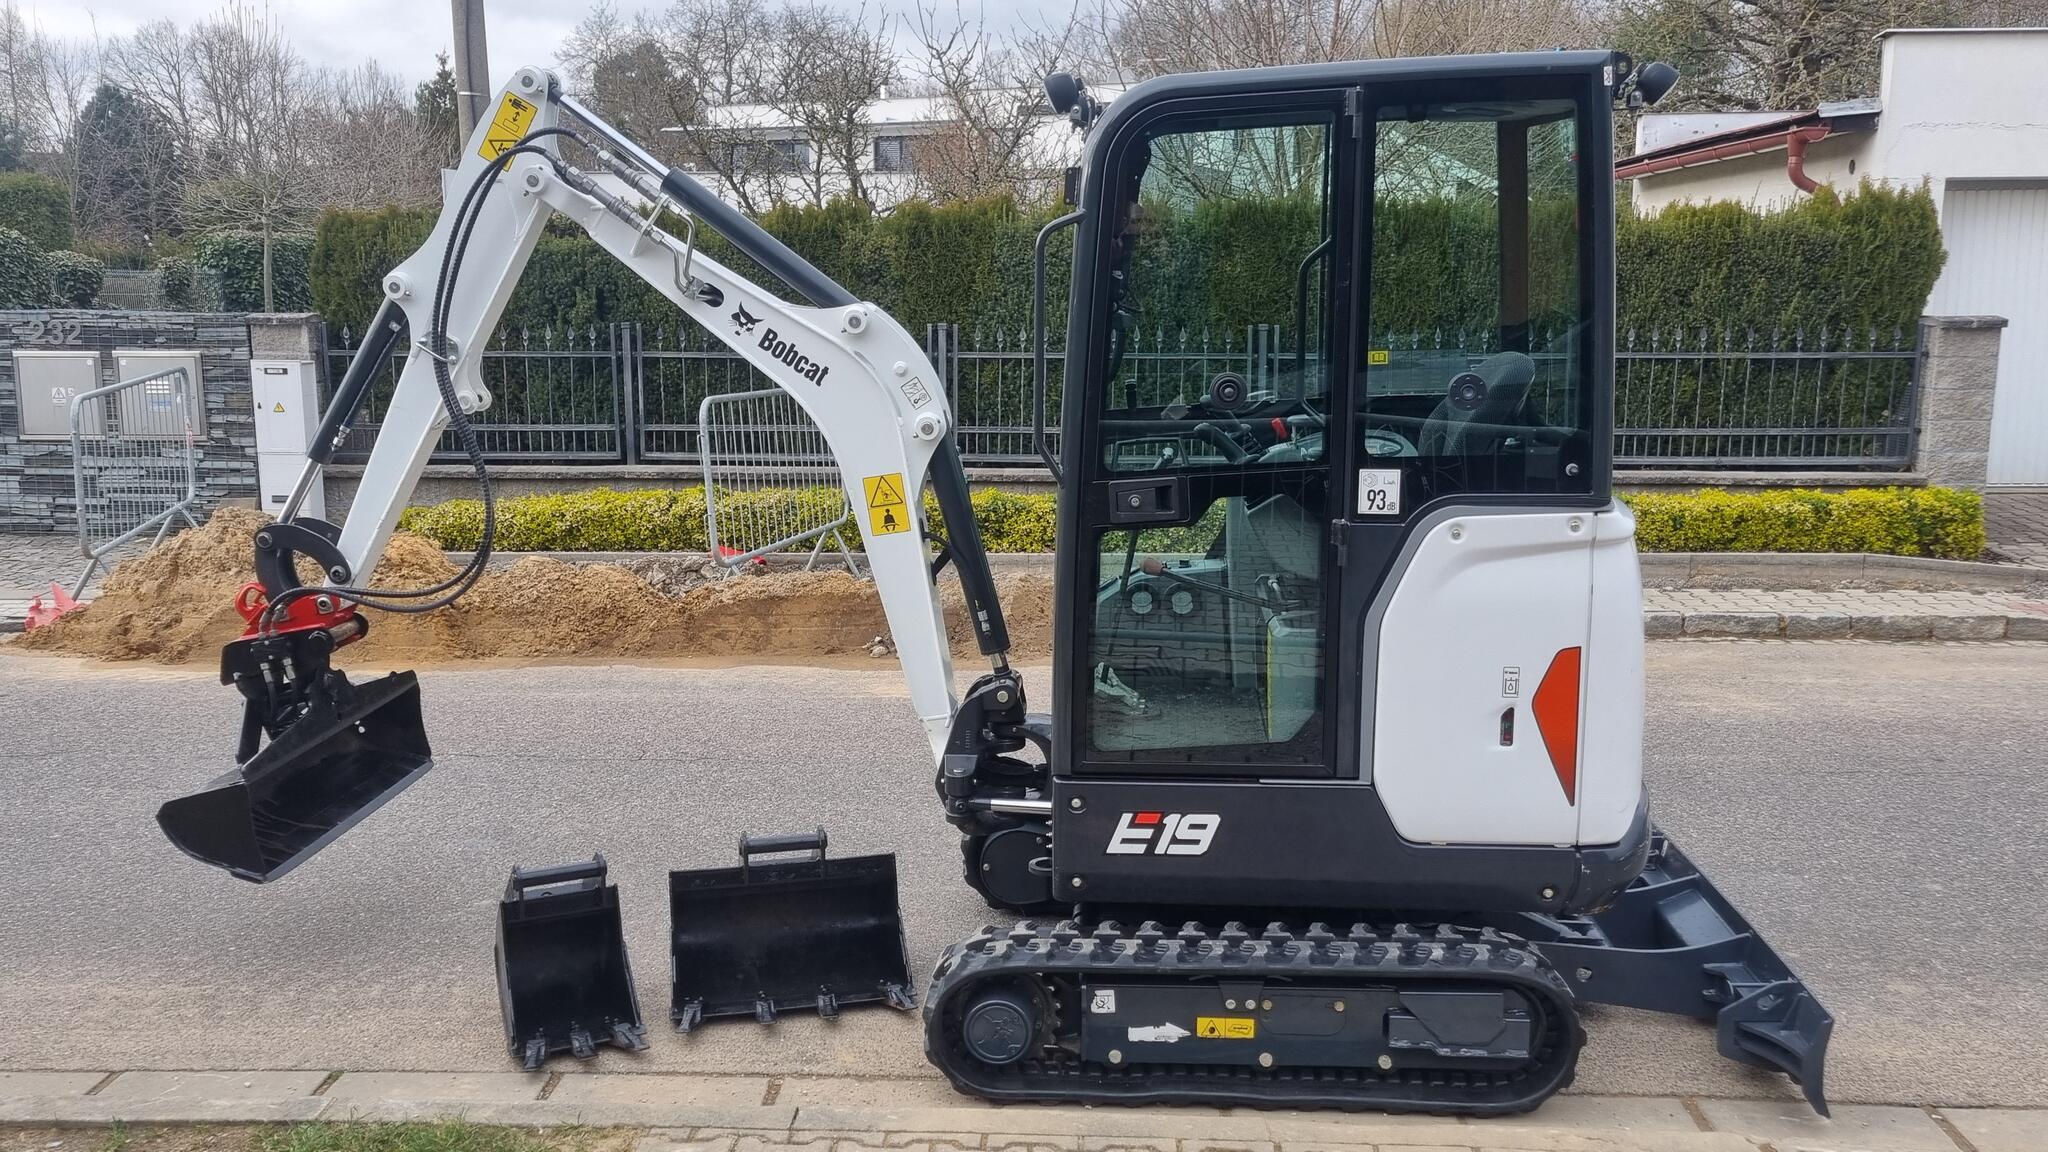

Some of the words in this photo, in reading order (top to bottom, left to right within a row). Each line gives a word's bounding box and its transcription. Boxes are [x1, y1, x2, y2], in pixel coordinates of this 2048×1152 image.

[29, 319, 82, 344] 232
[757, 327, 830, 388] Bobcat
[1367, 489, 1387, 511] 93
[1386, 501, 1396, 511] dB
[1105, 812, 1221, 856] E19
